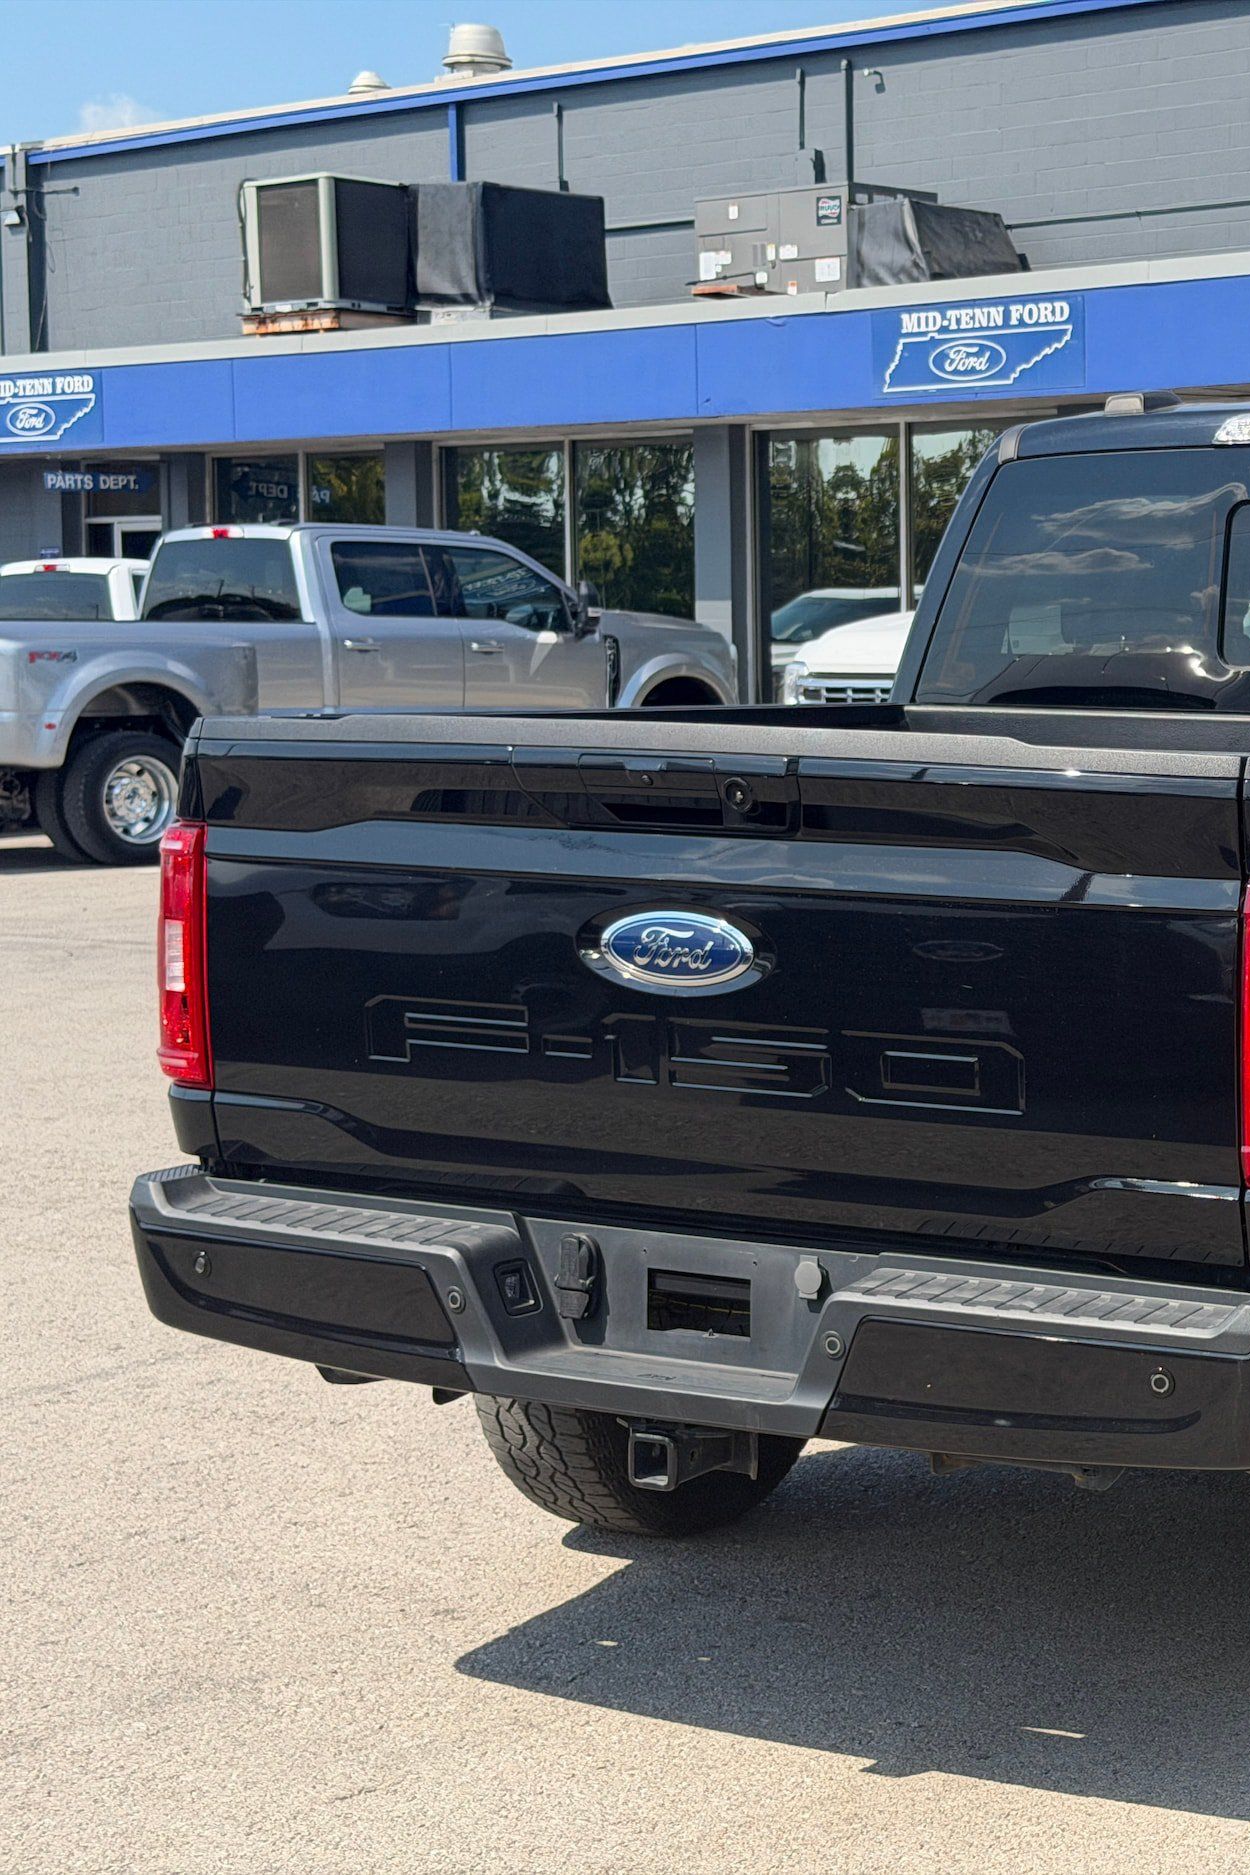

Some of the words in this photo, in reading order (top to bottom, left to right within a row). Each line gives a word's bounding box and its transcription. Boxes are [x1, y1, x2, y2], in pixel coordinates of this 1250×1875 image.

[901, 306, 1005, 333] MID-TENN
[1009, 302, 1070, 325] FORD
[944, 346, 990, 372] Ford
[0, 377, 53, 397] ID-TENN
[55, 374, 94, 394] FORD
[15, 407, 46, 429] Ford
[47, 473, 94, 489] PARTS
[99, 474, 139, 490] DEPT.
[633, 925, 714, 974] Ford
[364, 994, 1027, 1116] F-150
